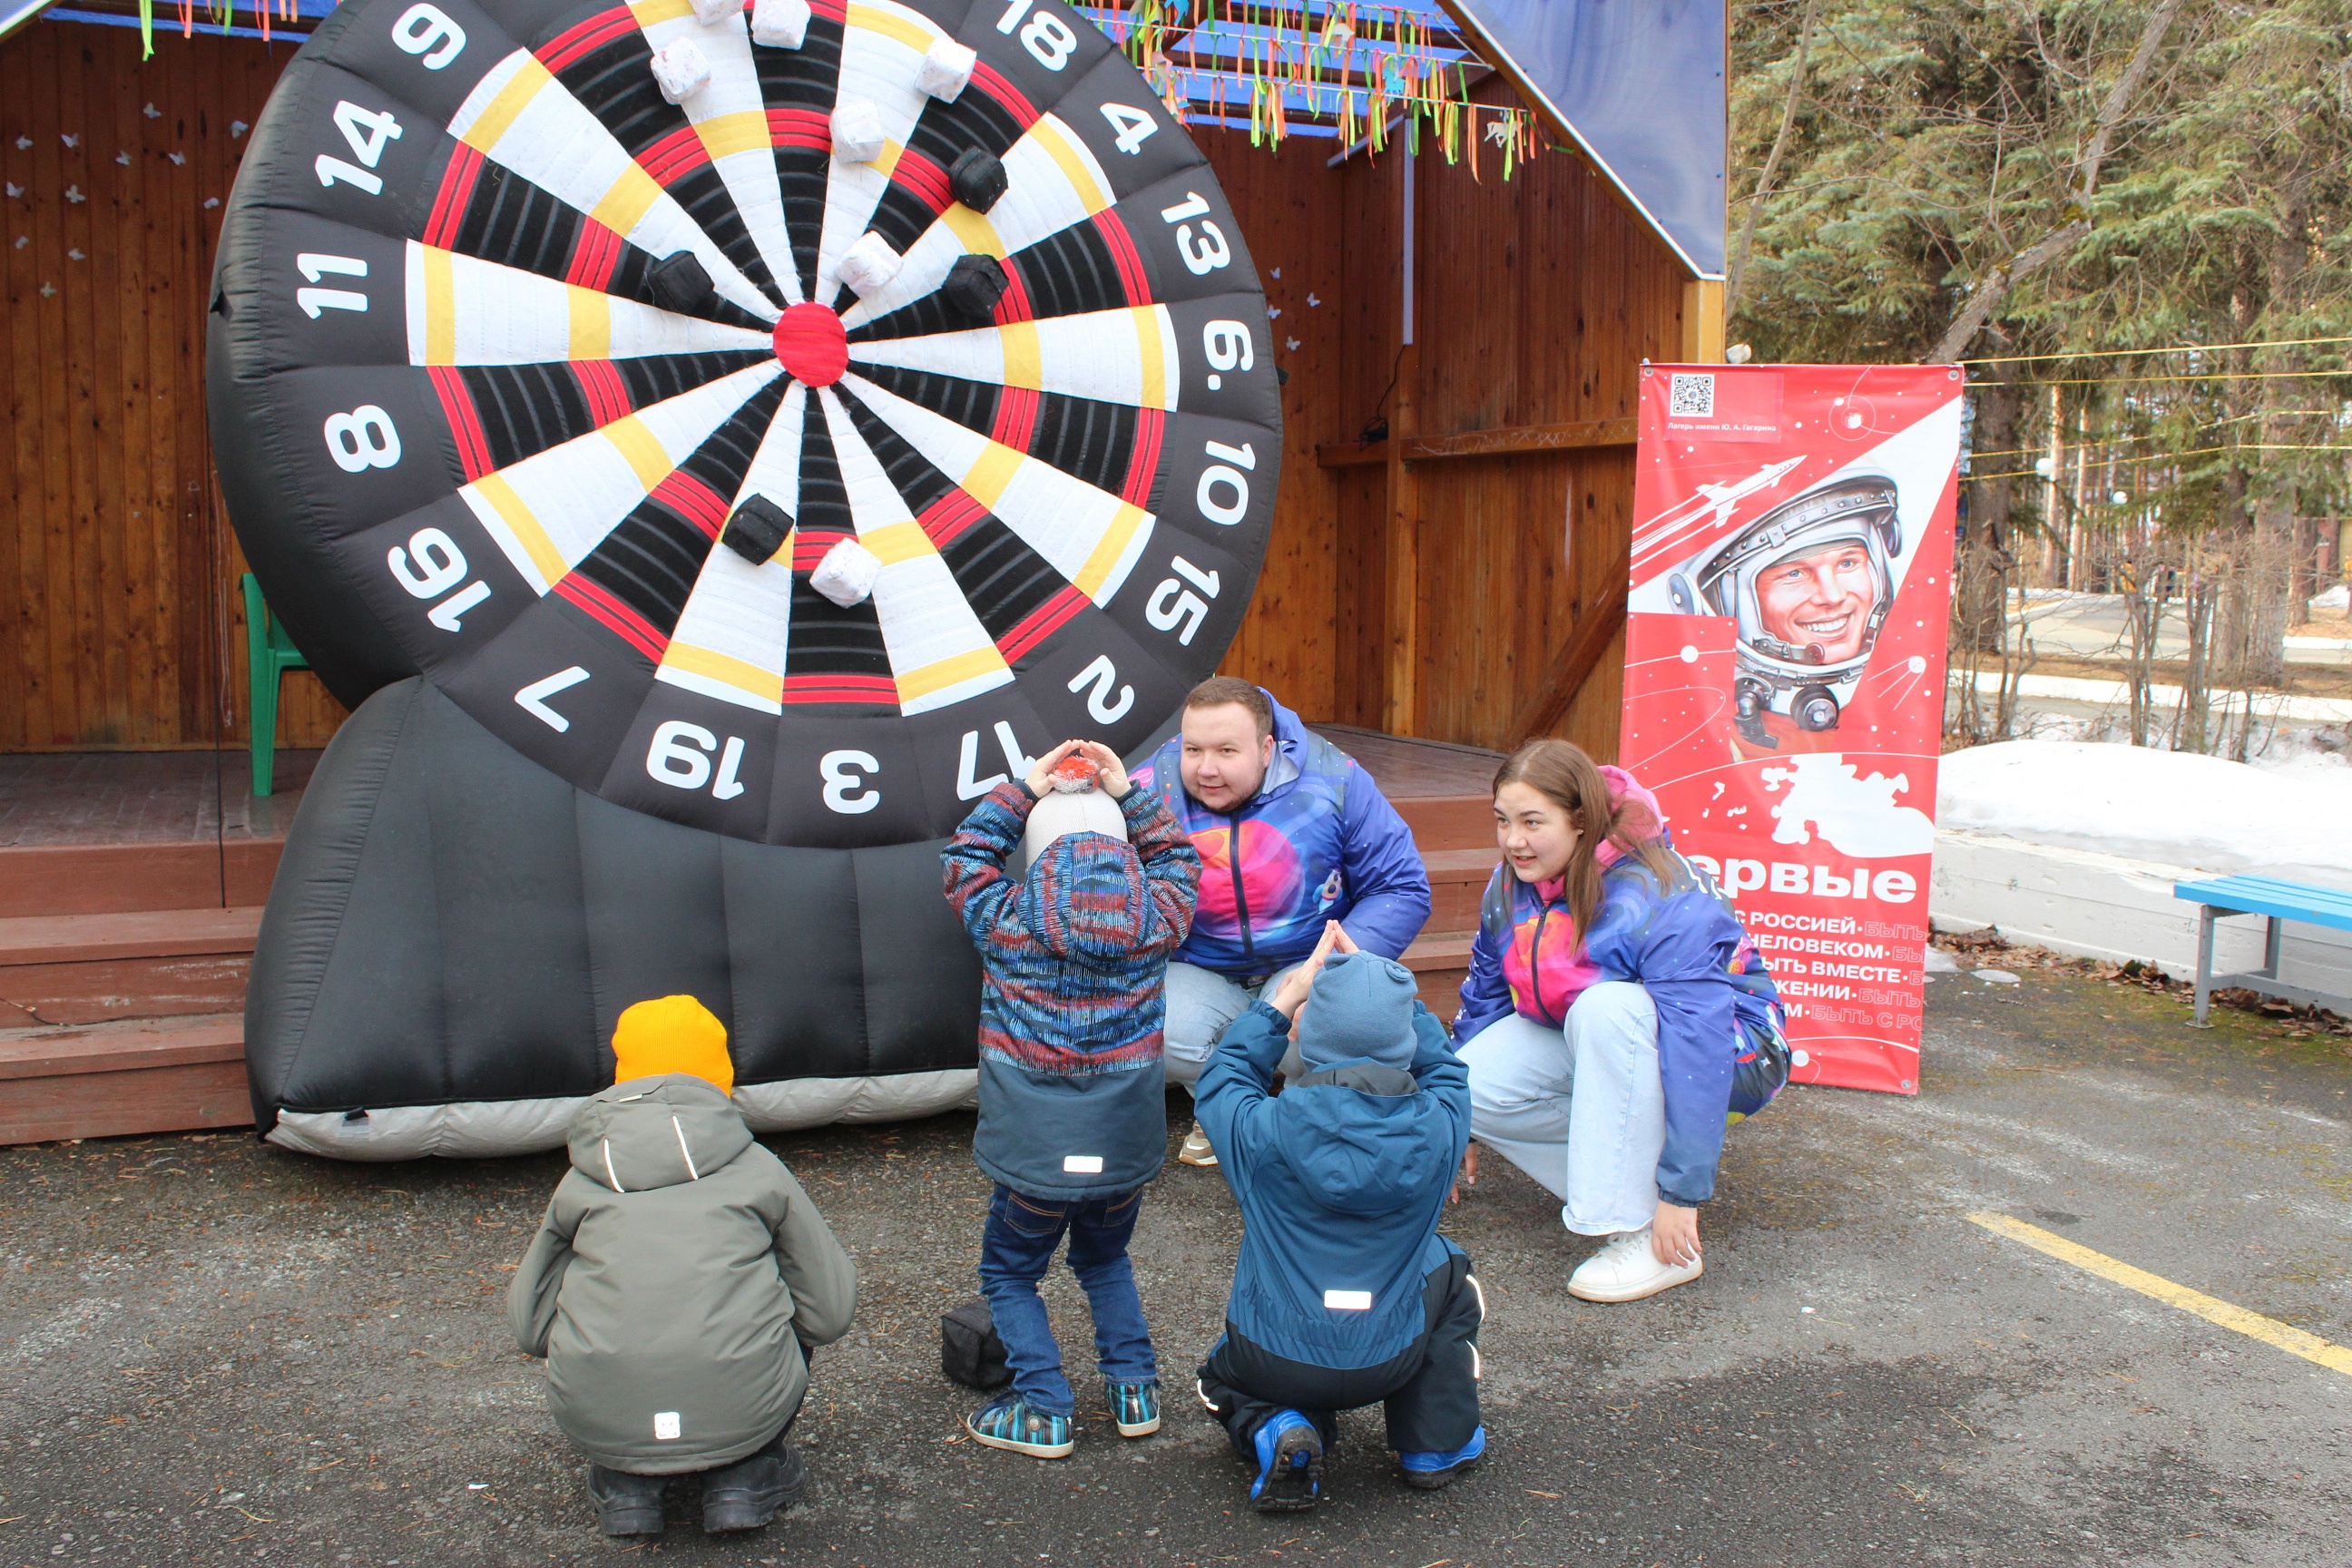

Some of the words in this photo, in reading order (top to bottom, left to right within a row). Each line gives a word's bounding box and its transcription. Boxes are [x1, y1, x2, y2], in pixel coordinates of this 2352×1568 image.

[391, 3, 466, 70] 9
[995, 0, 1077, 72] 18
[314, 100, 403, 195] 14
[1099, 102, 1159, 155] 4
[1161, 191, 1231, 275] 13
[297, 252, 368, 319] 11
[324, 404, 401, 473] 8
[1667, 422, 1693, 431] Лагерь
[1742, 424, 1777, 432] Гагарина
[1196, 440, 1256, 525] 10
[387, 527, 492, 632] 16
[1145, 555, 1220, 646] 15
[514, 665, 591, 733] 7
[1067, 654, 1135, 725] 2
[646, 720, 745, 800] 19
[819, 750, 880, 814] 3
[956, 720, 1035, 800] 17
[1684, 853, 1916, 904] ервые
[1749, 911, 1856, 936] РОССИЕЙ
[1864, 920, 1927, 941] БЫТЬ
[1761, 956, 1808, 974] ЫТЬ
[1811, 960, 1901, 984] ВМЕСТЕ
[1771, 979, 1850, 1001] ЖЕНИИ
[1858, 987, 1921, 1009] БЫТЬ
[1811, 1004, 1874, 1025] БЫТЬ
[1877, 1012, 1894, 1028] С
